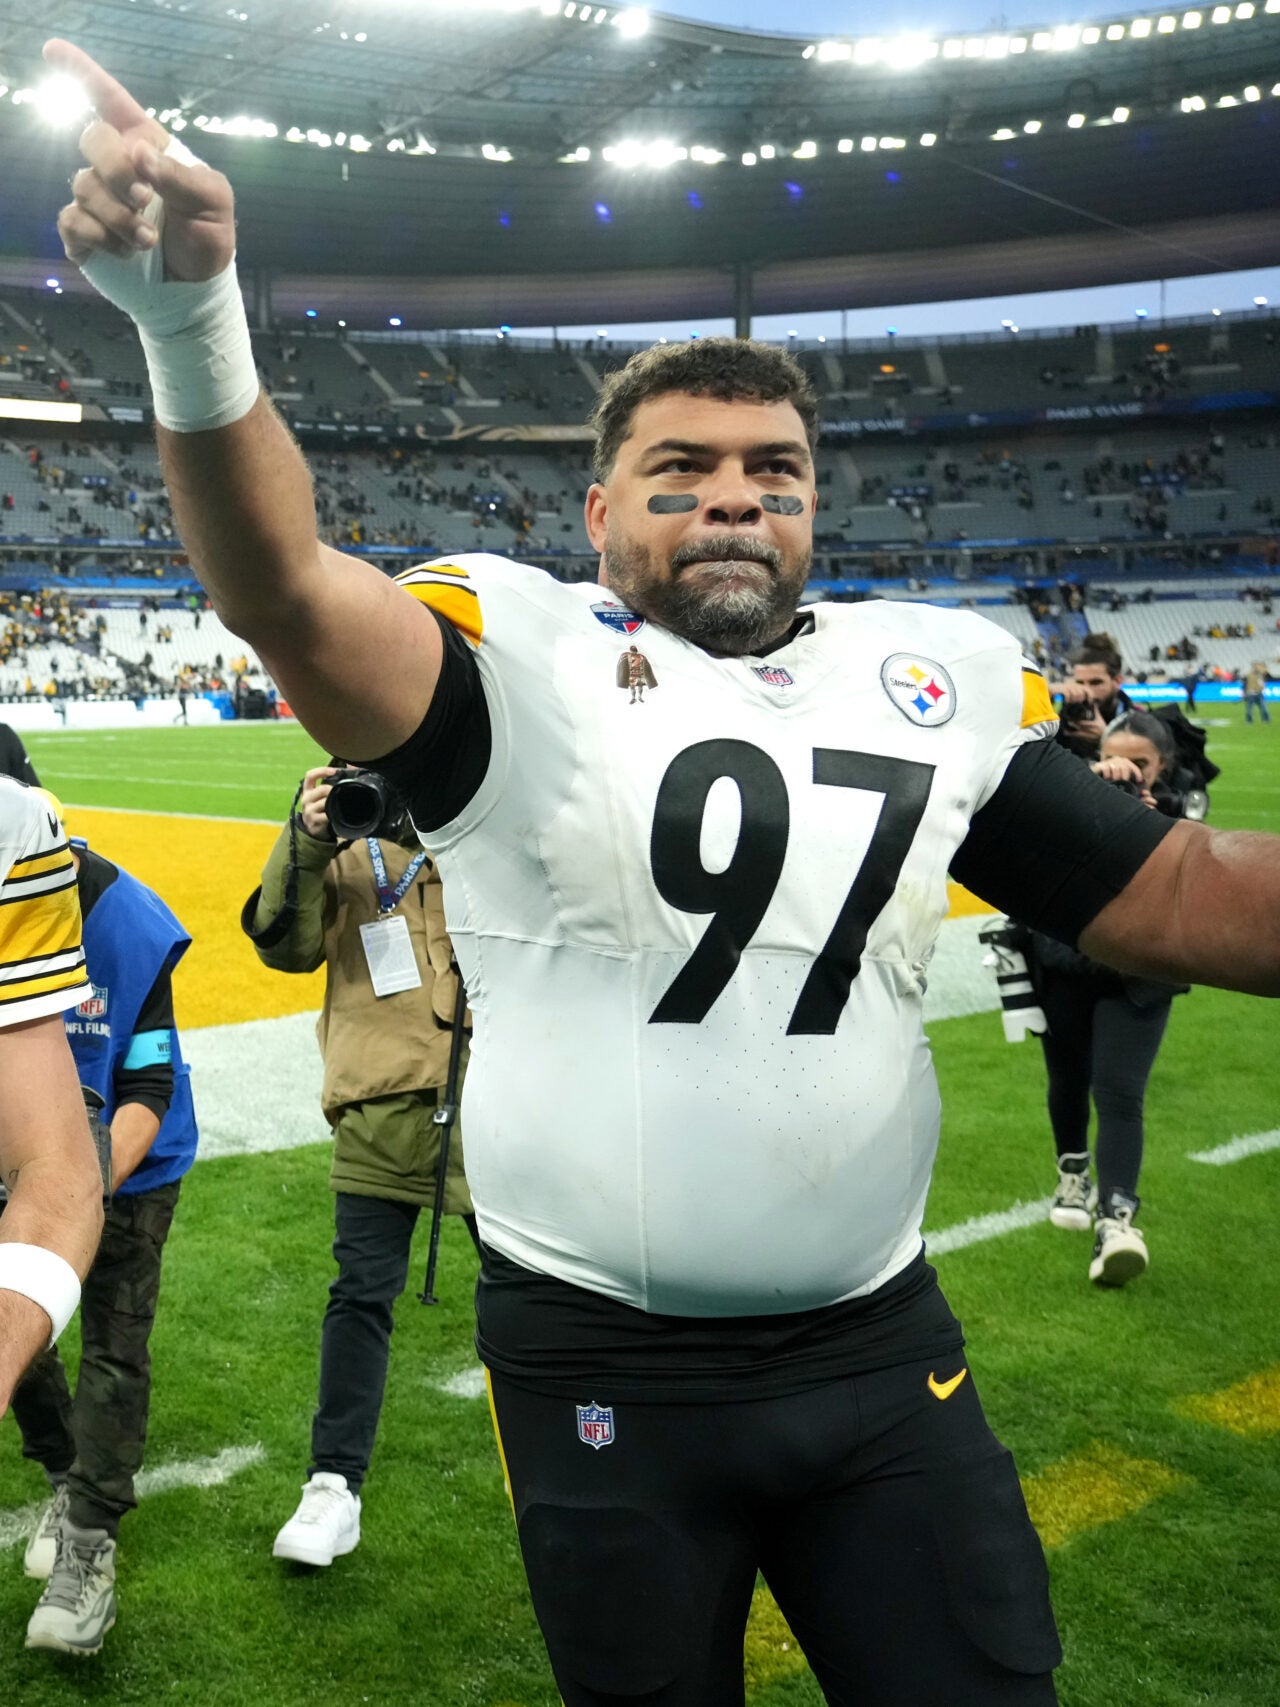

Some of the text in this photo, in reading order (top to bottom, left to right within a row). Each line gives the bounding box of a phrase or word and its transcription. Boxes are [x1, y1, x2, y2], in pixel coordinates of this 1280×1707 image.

[763, 673, 791, 685] NFL
[889, 677, 919, 692] Steelers
[394, 864, 419, 897] PARIS
[647, 737, 938, 1037] 97
[80, 1000, 103, 1015] NFL
[65, 1022, 84, 1034] NFL
[583, 1422, 609, 1441] NFL
